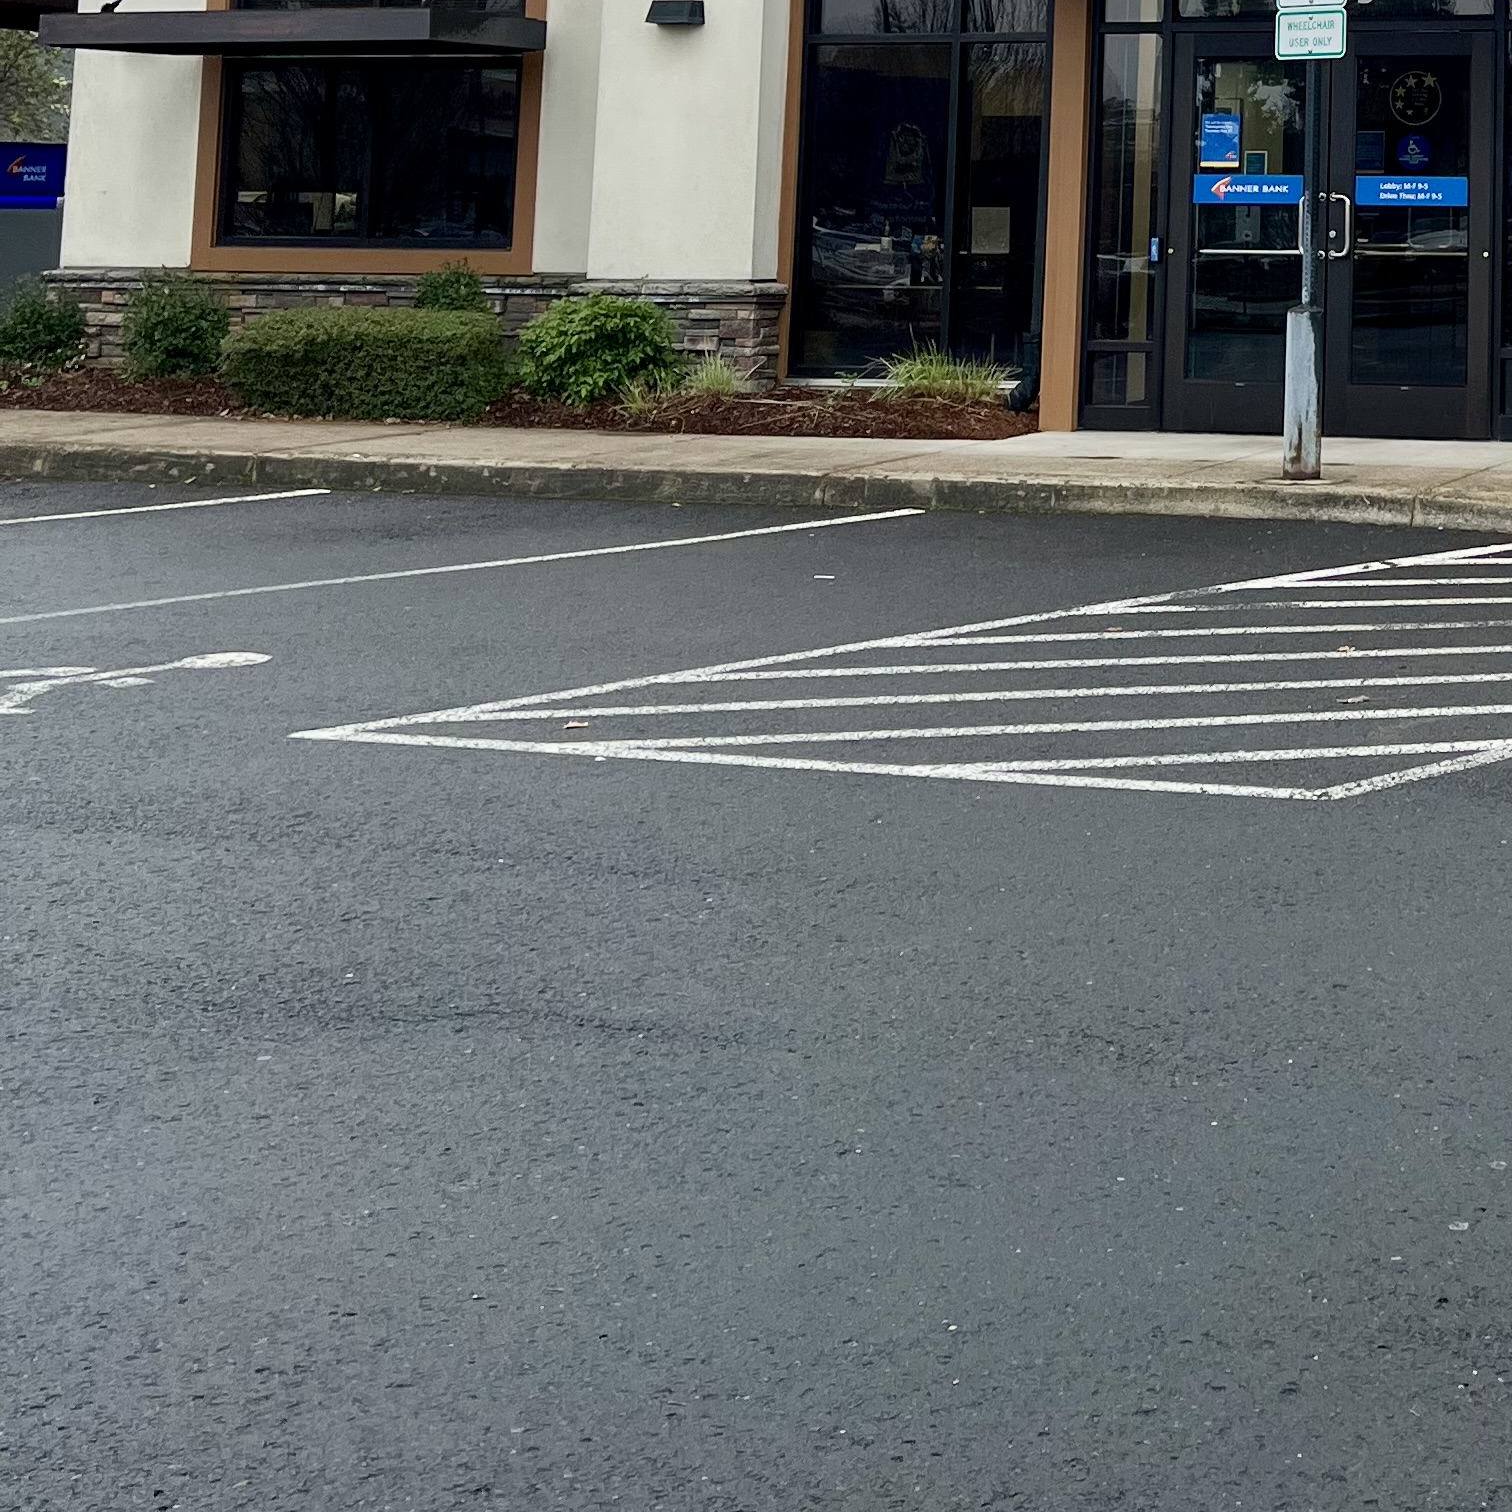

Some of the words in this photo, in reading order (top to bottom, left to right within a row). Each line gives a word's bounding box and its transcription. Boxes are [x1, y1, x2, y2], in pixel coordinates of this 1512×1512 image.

[1287, 20, 1335, 31] WHEELCHAIR
[1289, 37, 1309, 48] USER
[1312, 36, 1332, 47] ONLY
[1220, 184, 1259, 193] BANNER
[1262, 184, 1289, 193] BANK
